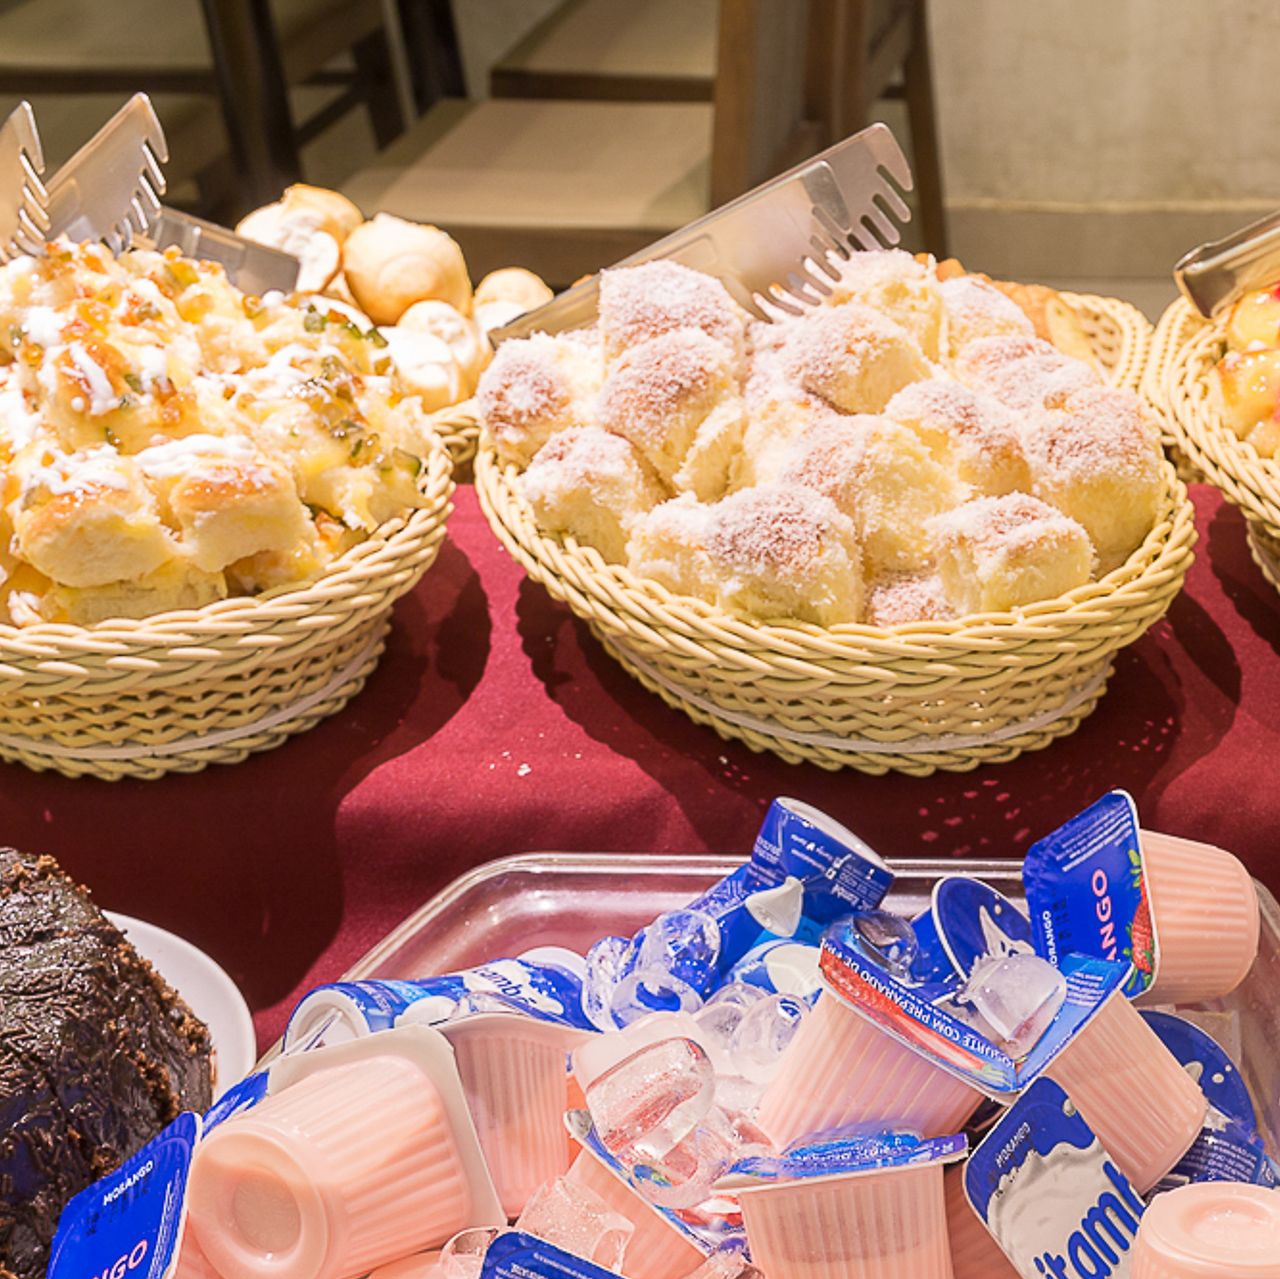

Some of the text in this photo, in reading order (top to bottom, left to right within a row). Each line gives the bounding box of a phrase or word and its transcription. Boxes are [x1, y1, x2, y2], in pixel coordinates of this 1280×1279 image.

[1042, 910, 1058, 968] ORANGO
[842, 956, 861, 975] DE
[859, 969, 932, 1023] PREPARADO
[932, 1016, 962, 1040] COM
[995, 1120, 1032, 1169] MORANGO
[101, 1160, 155, 1206] MORANGO
